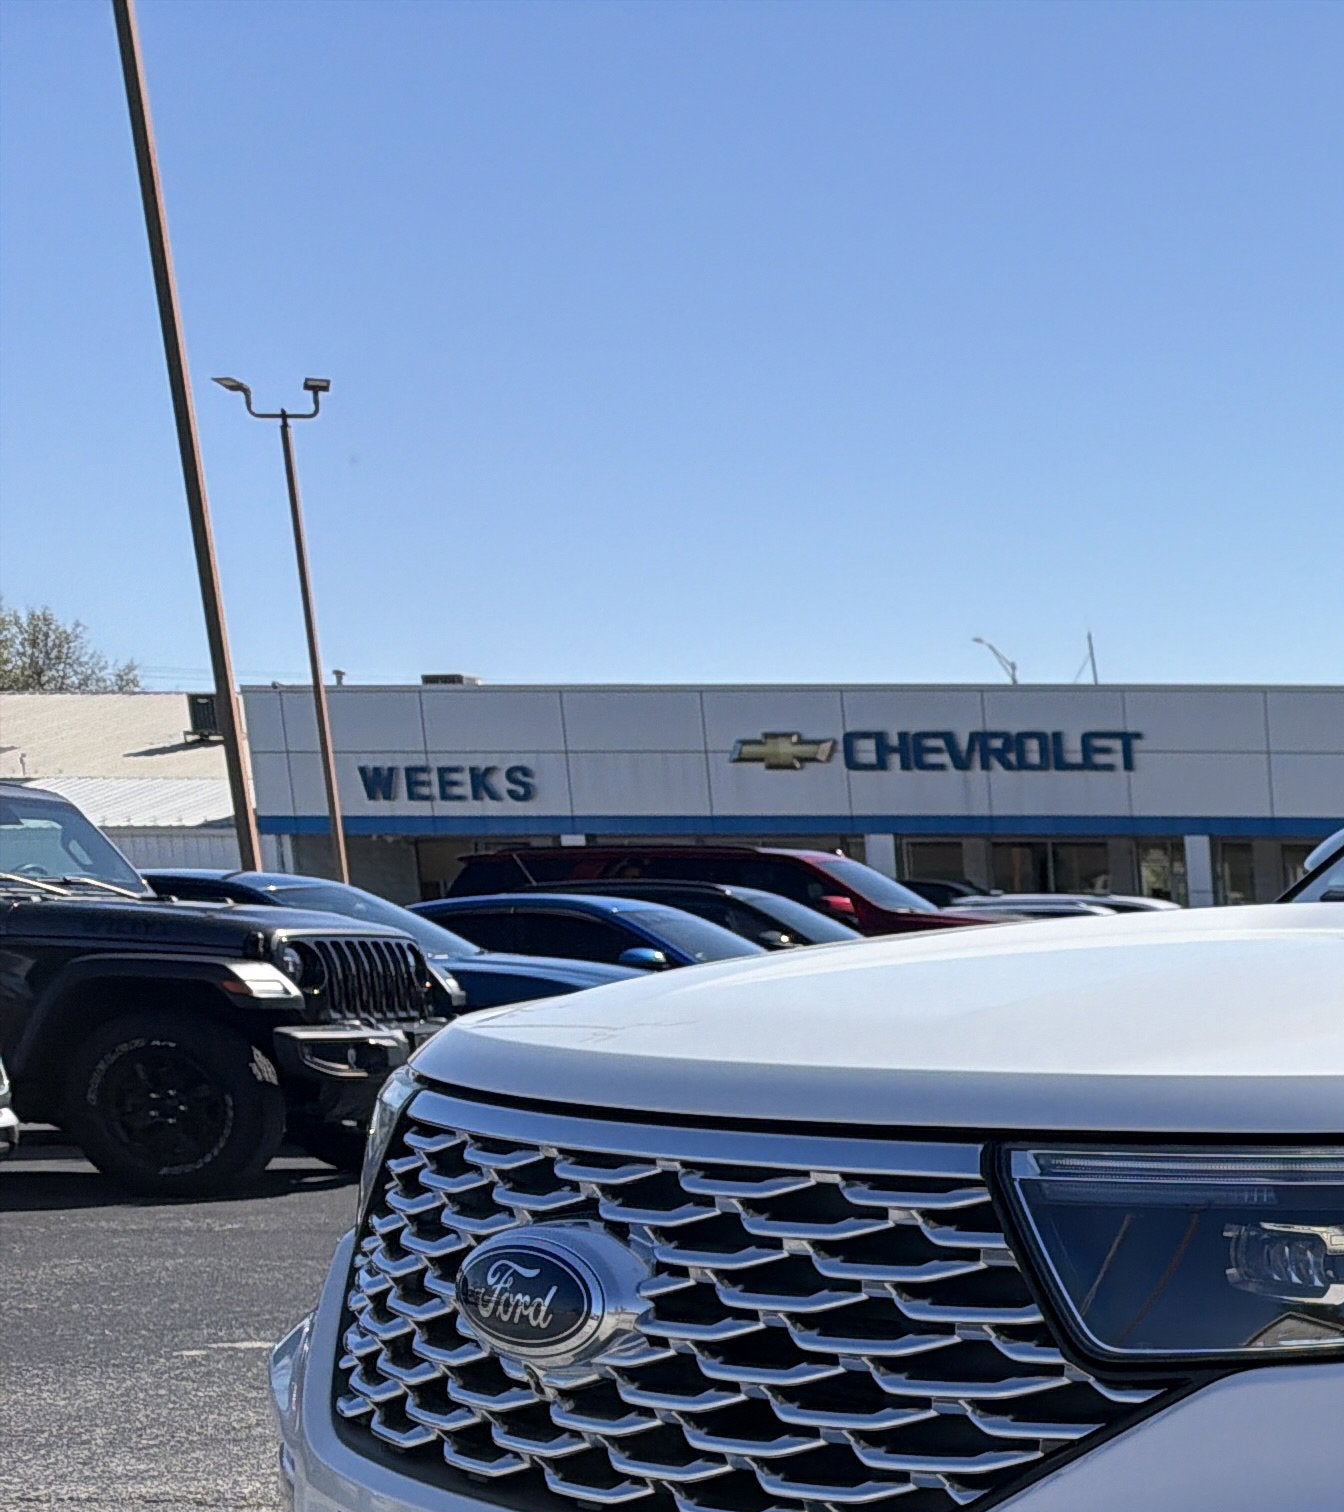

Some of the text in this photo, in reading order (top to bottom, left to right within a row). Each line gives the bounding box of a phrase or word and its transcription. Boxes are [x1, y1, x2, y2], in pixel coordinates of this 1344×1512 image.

[844, 731, 1142, 771] CHEVROLET
[357, 764, 539, 803] WEEKS
[478, 1259, 559, 1329] Ford
